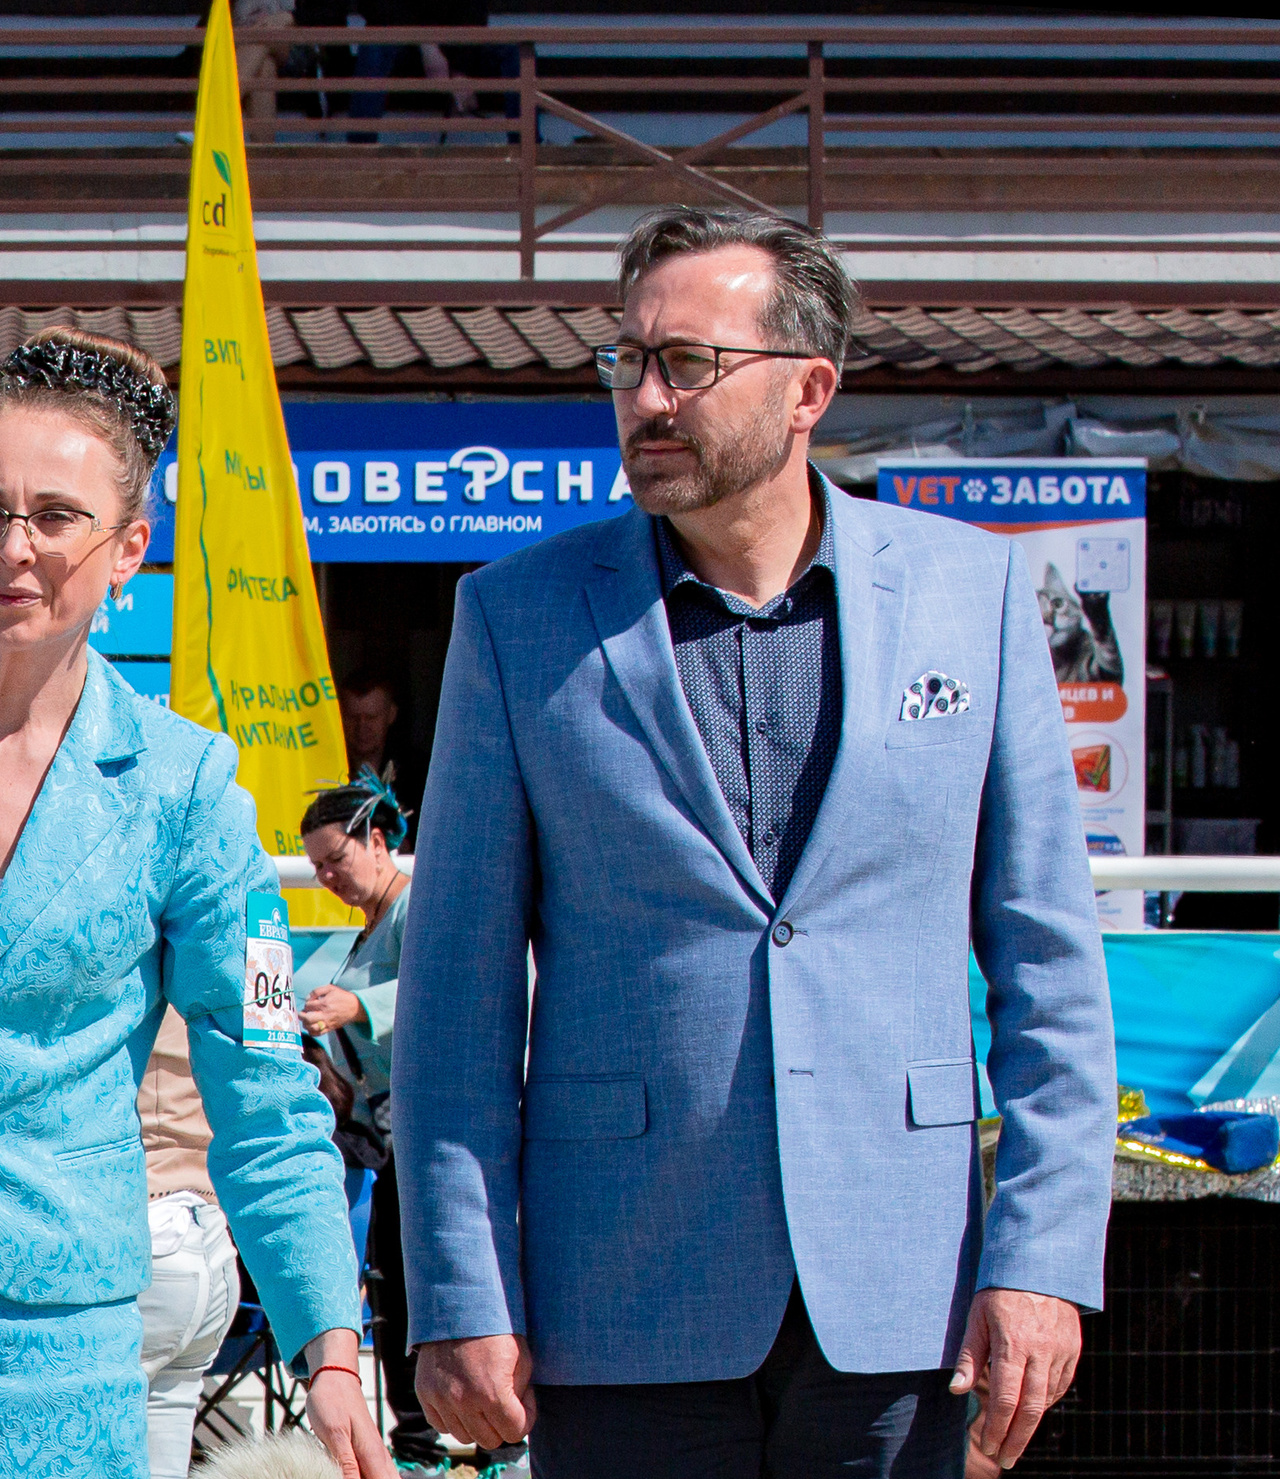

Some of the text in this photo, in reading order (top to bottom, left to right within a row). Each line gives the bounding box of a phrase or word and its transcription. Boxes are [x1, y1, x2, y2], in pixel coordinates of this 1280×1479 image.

[892, 475, 961, 505] VET
[990, 475, 1131, 505] ЗАБОТА
[328, 516, 425, 533] ЗАБОТЯСЬ
[431, 516, 444, 532] О
[450, 516, 542, 533] ГЛАВНОМ
